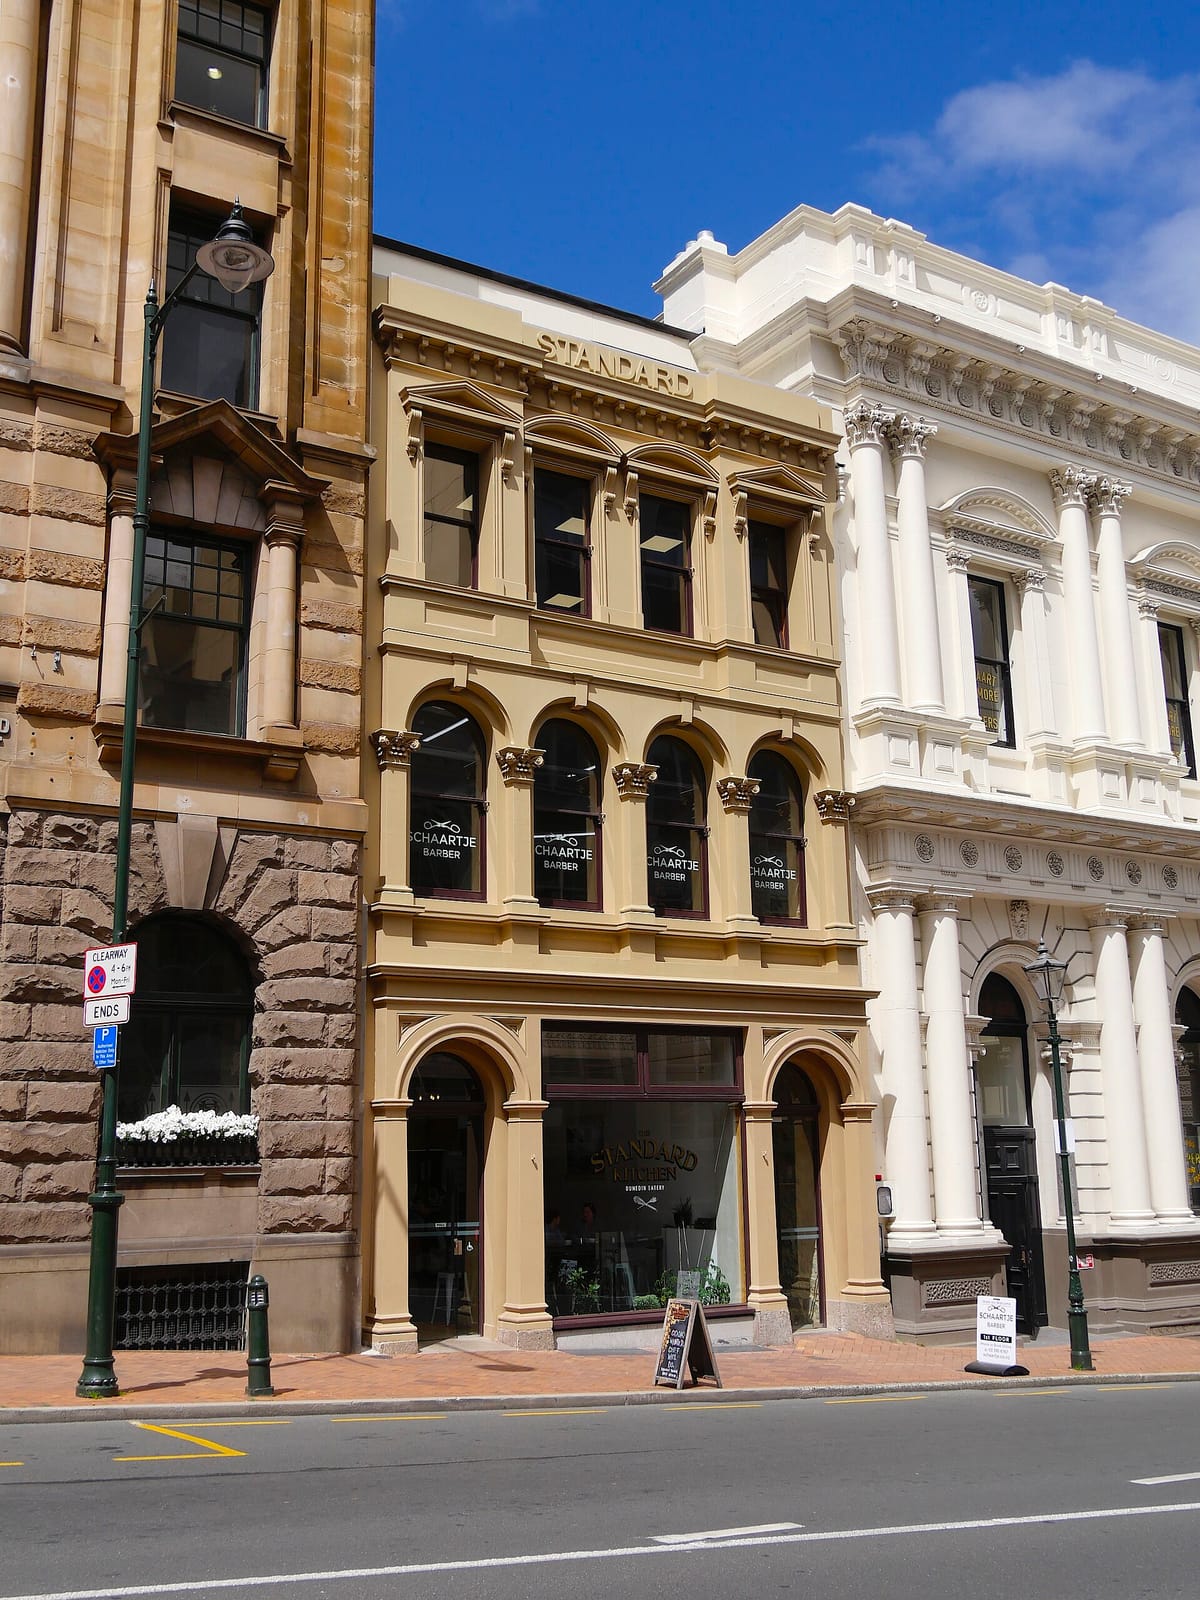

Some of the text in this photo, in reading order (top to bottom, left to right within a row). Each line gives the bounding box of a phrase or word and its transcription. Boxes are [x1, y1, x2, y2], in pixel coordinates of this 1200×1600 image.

[537, 330, 694, 400] STANDARD
[423, 847, 461, 860] BARBER
[535, 844, 593, 860] CHAARTJE
[543, 859, 579, 872] BARBER
[647, 856, 699, 871] CHAARTJE
[654, 870, 686, 882] BARBER
[750, 866, 797, 880] CHAARTJE
[755, 880, 785, 890] BARBER
[92, 948, 128, 962] CLEARWAY
[93, 1004, 119, 1018] ENDS
[102, 1028, 110, 1042] P
[590, 1138, 698, 1173] STANDARD
[614, 1166, 677, 1182] KITCHEN
[979, 1312, 1014, 1322] SCHAARTJE
